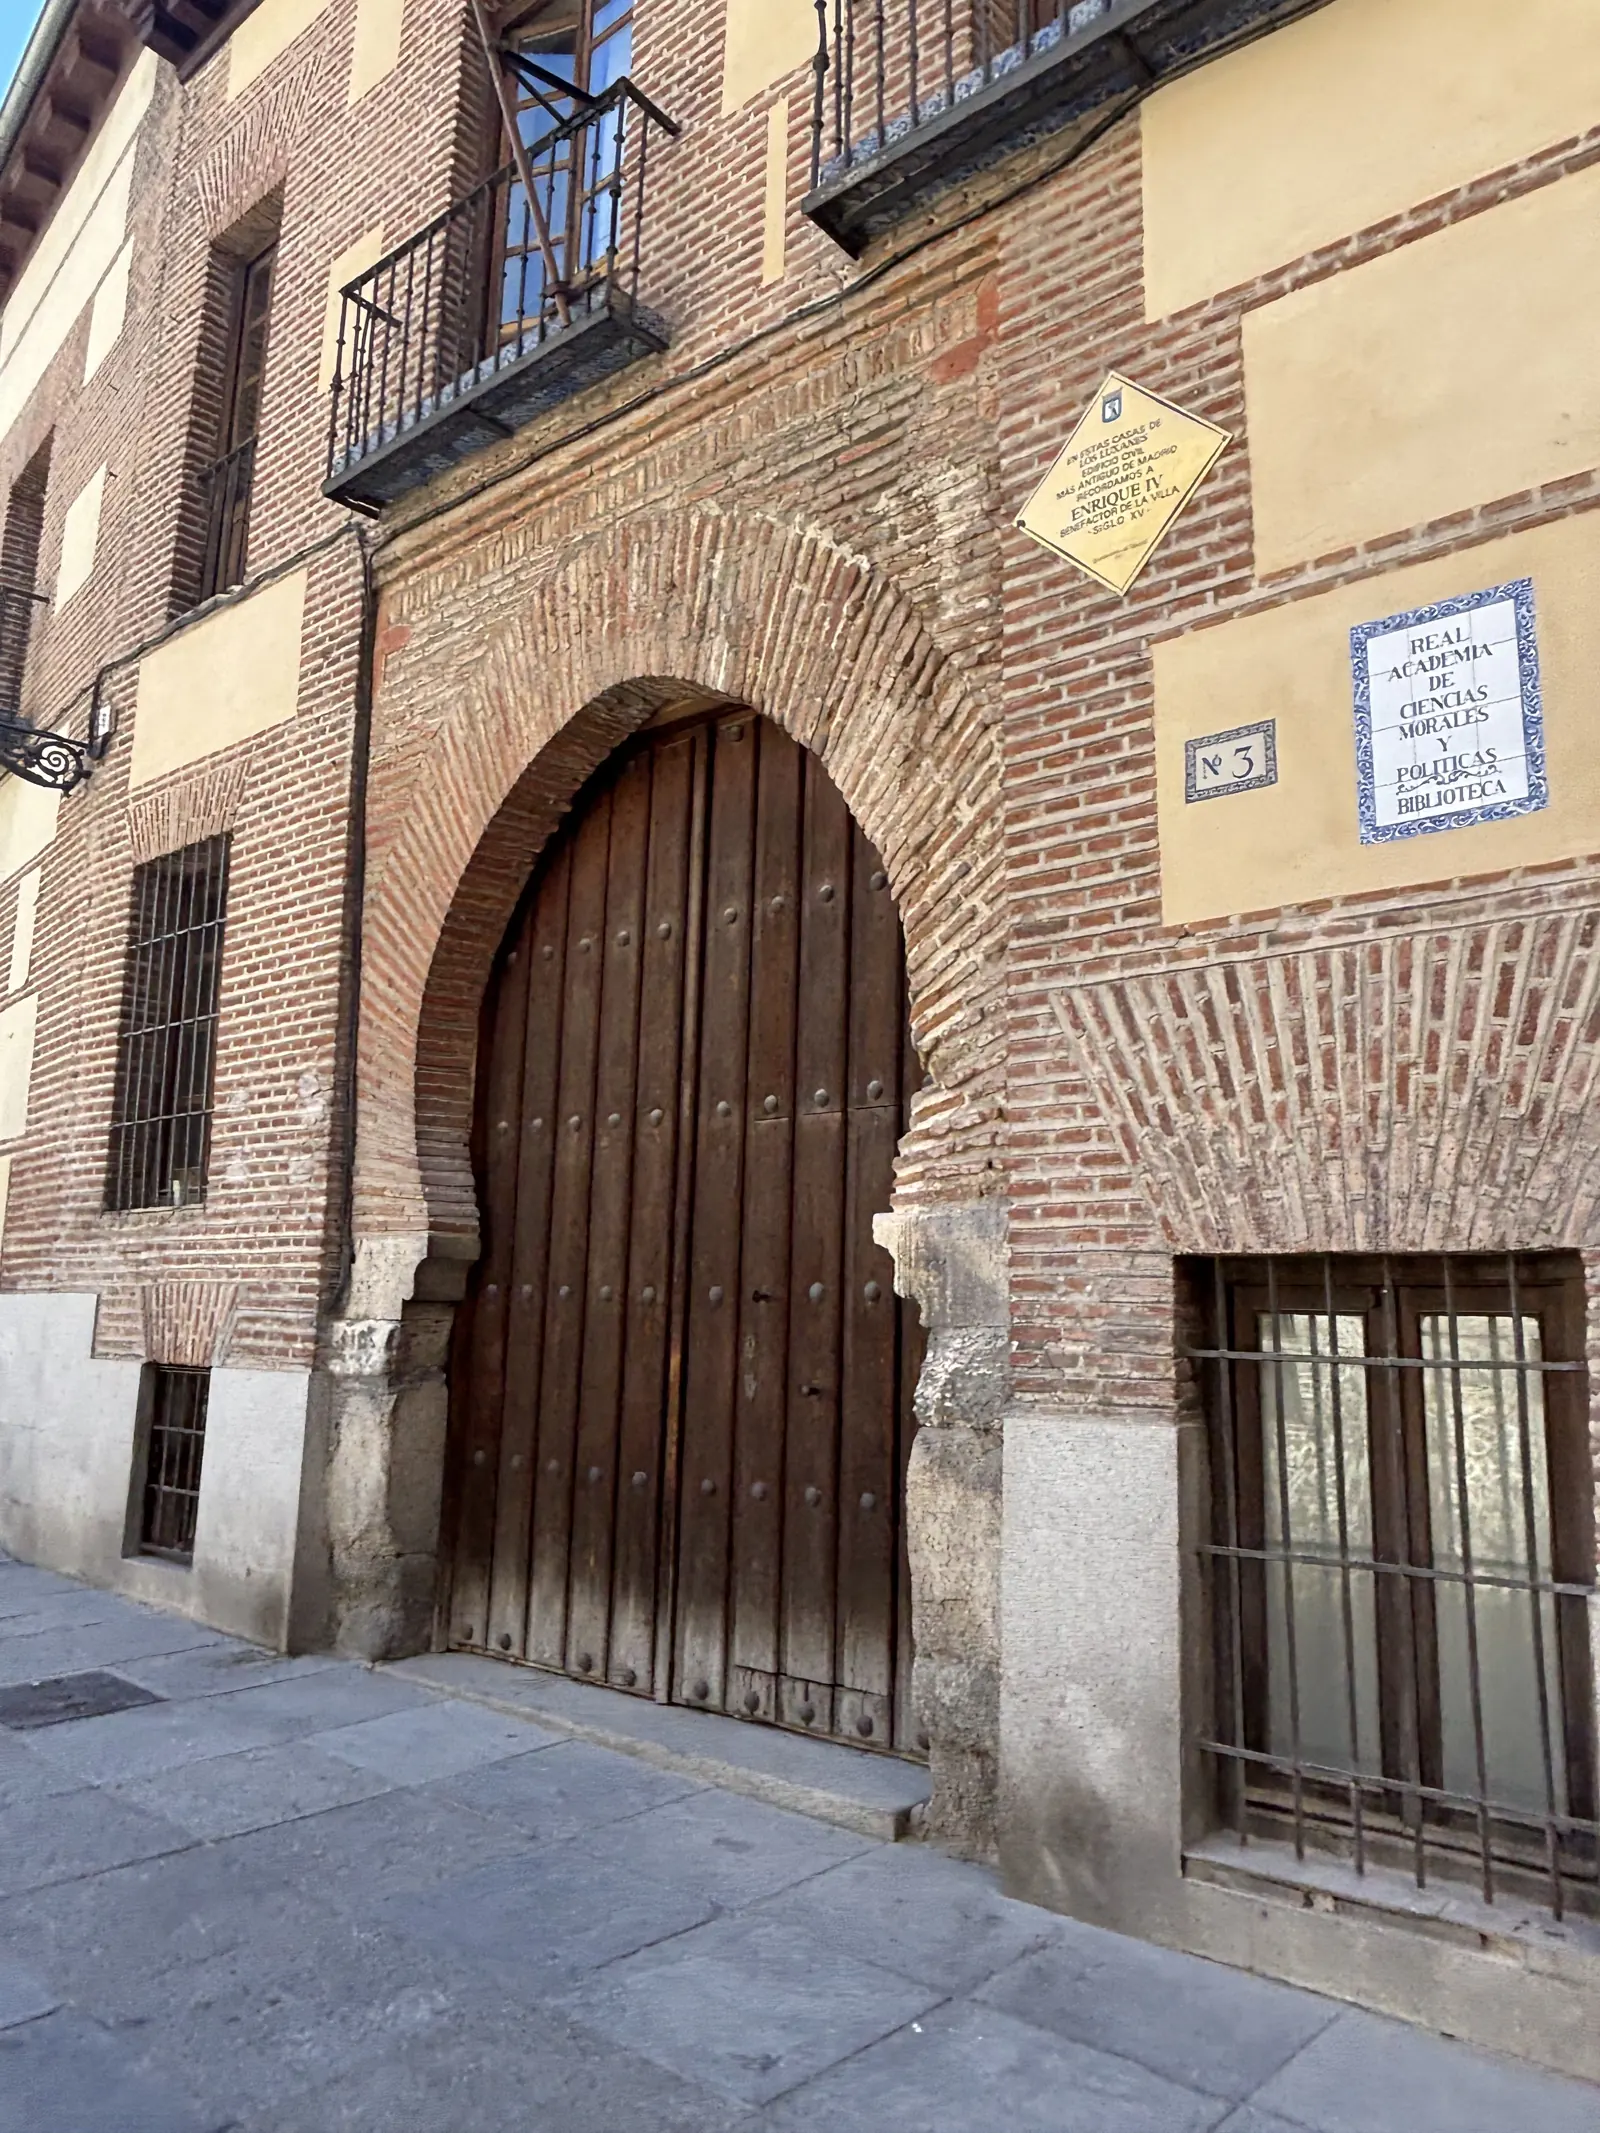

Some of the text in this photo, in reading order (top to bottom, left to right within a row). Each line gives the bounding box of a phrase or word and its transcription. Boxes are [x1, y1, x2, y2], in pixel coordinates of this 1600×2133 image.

[1080, 439, 1110, 458] ESTAS
[1111, 425, 1145, 443] CASAS
[1149, 419, 1162, 430] DE
[1078, 467, 1119, 490] ANTIGUO
[1122, 461, 1135, 471] DE
[1137, 445, 1177, 466] MADRID
[1080, 454, 1097, 467] LOS
[1081, 448, 1144, 477] EDIFICIO CIVIL
[1071, 475, 1162, 521] ENRIQUE IV
[1076, 466, 1153, 501] RECORDAMOS A
[1060, 486, 1180, 537] BENEFACTOR DE LA VILLA
[1411, 627, 1471, 654] REAL
[1388, 644, 1492, 682] ACADEMIA
[1429, 672, 1454, 691] DE
[1400, 685, 1487, 719] CIENCIAS
[1399, 706, 1489, 740] MORALES
[1437, 736, 1452, 752] Y
[1232, 746, 1254, 778] 3
[1397, 747, 1497, 781] POLITICAS
[1397, 780, 1506, 814] BIBLIOTECA
